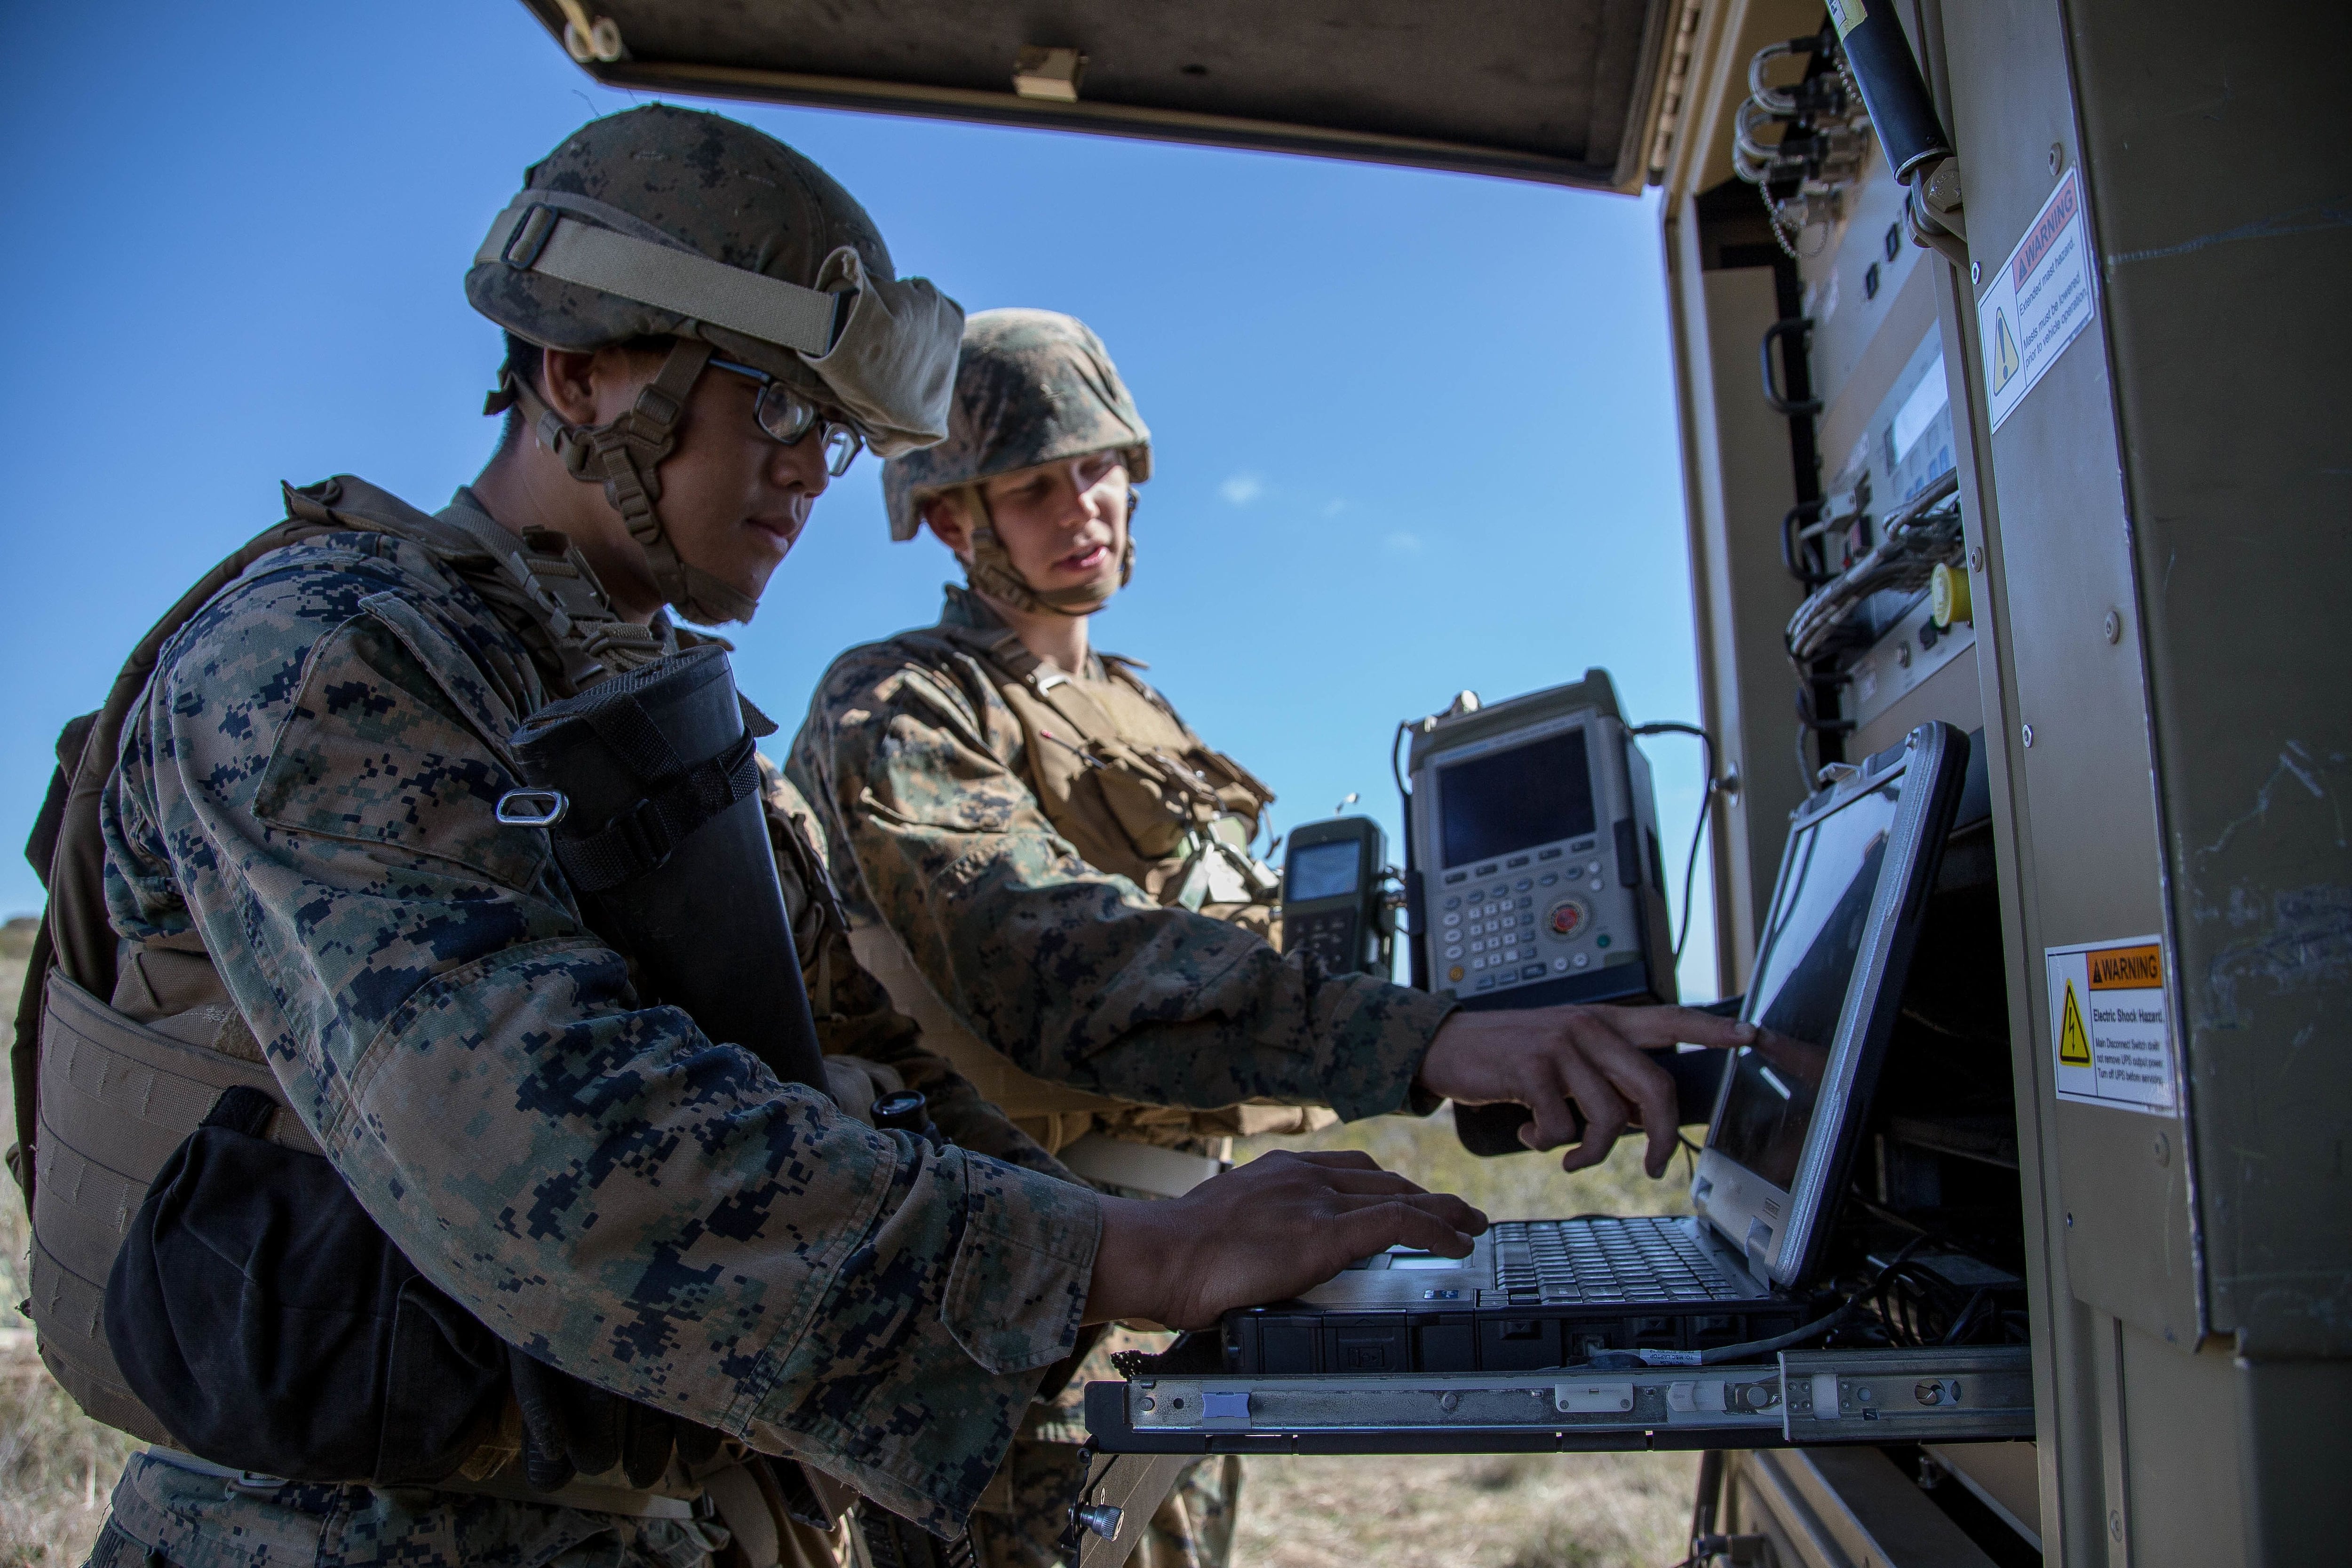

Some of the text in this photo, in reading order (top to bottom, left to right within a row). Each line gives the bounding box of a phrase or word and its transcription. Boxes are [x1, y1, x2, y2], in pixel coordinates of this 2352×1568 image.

[2025, 189, 2073, 267] WARNING
[2019, 237, 2075, 316] Extended mast hazard.
[2024, 327, 2038, 350] Masts
[2038, 310, 2051, 330] must
[2051, 302, 2058, 315] be
[2059, 270, 2081, 306] lowered
[2026, 350, 2036, 370] prior
[2037, 342, 2042, 354] to
[2043, 320, 2060, 346] vehicle
[2061, 288, 2088, 324] operation.
[2102, 955, 2158, 981] WARNING
[2093, 1008, 2116, 1022] Electric
[2117, 1008, 2137, 1022] Shock
[2096, 1037, 2106, 1048] Main
[2106, 1037, 2131, 1049] Disconnect
[2131, 1039, 2147, 1050] Switch
[2105, 1055, 2121, 1065] remove
[2121, 1054, 2132, 1066] UPS
[2098, 1067, 2108, 1078] Turn
[2115, 1069, 2125, 1081] UPS
